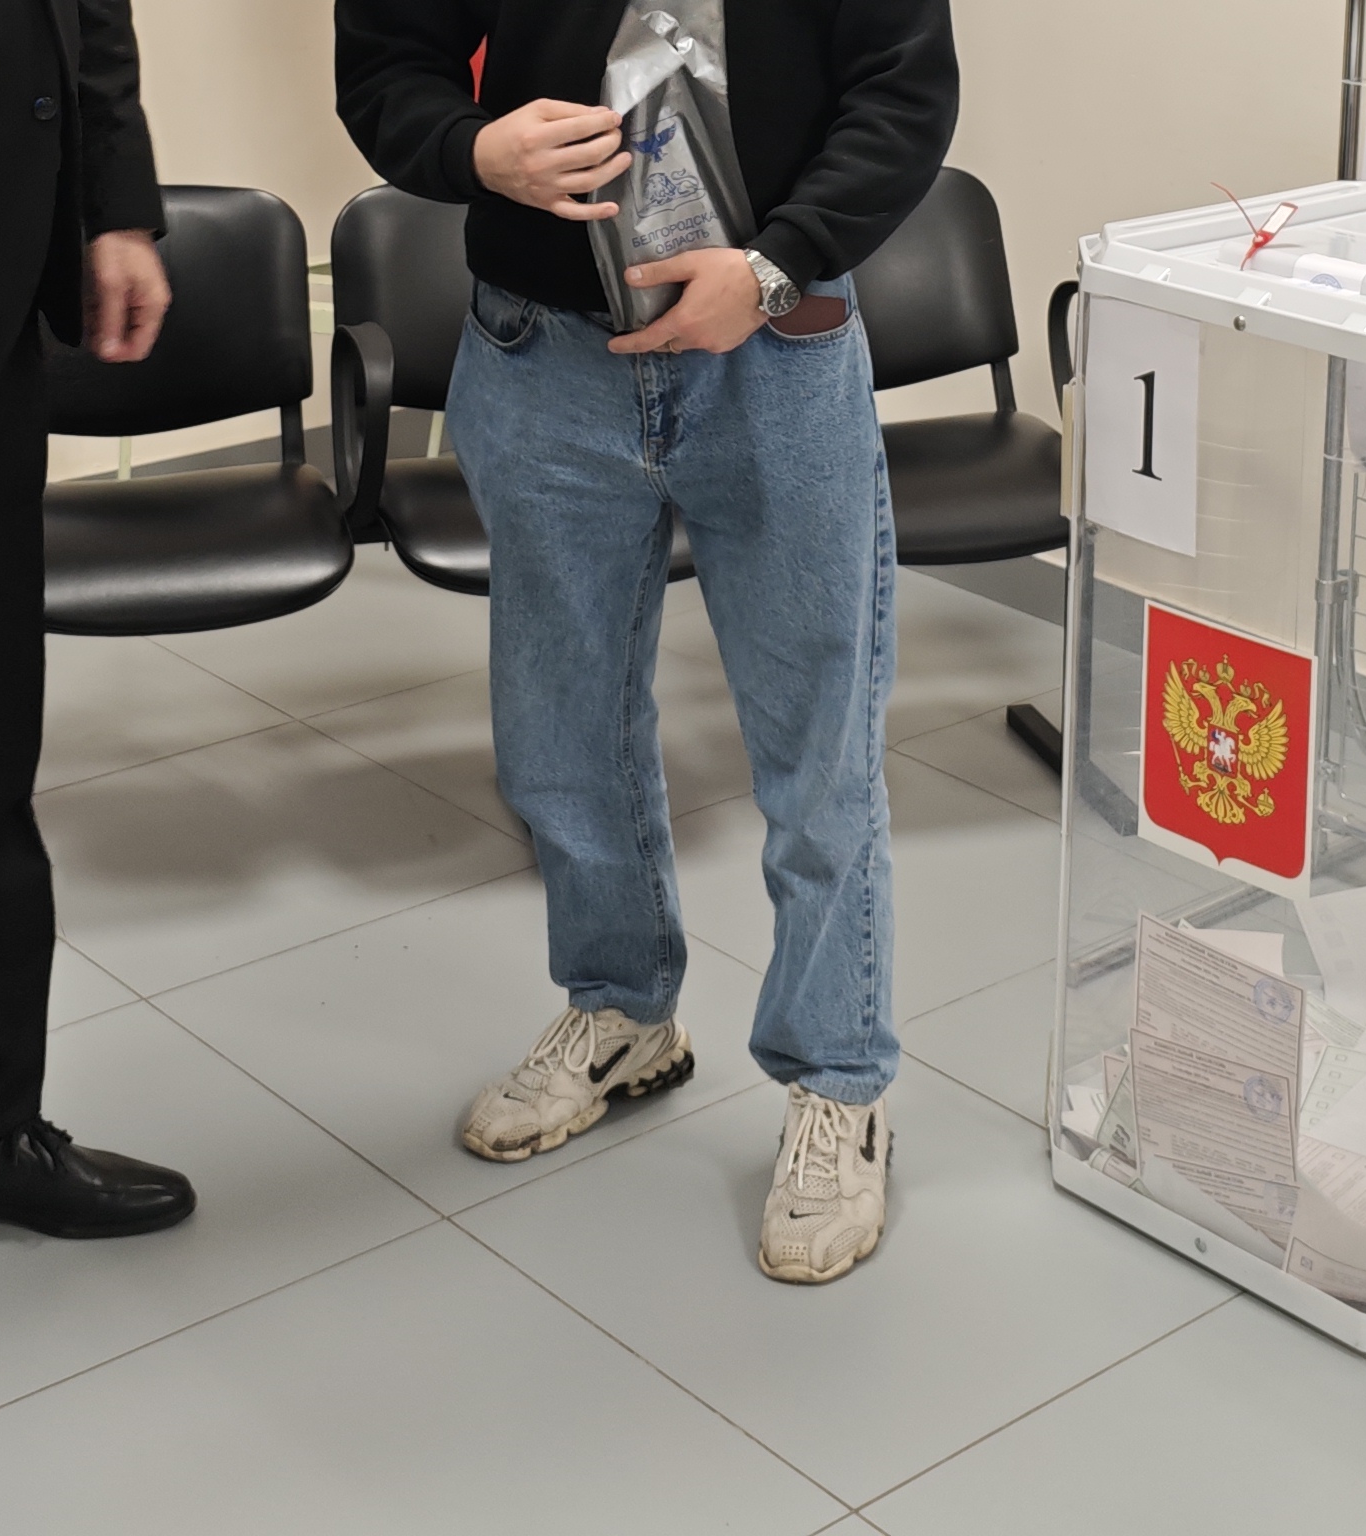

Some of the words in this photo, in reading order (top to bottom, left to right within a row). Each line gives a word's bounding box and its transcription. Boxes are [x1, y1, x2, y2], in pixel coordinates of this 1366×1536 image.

[631, 212, 718, 248] БЕЛГОРОДСКА
[655, 228, 710, 255] ОБЛАСТЬ
[1132, 370, 1163, 482] 1
